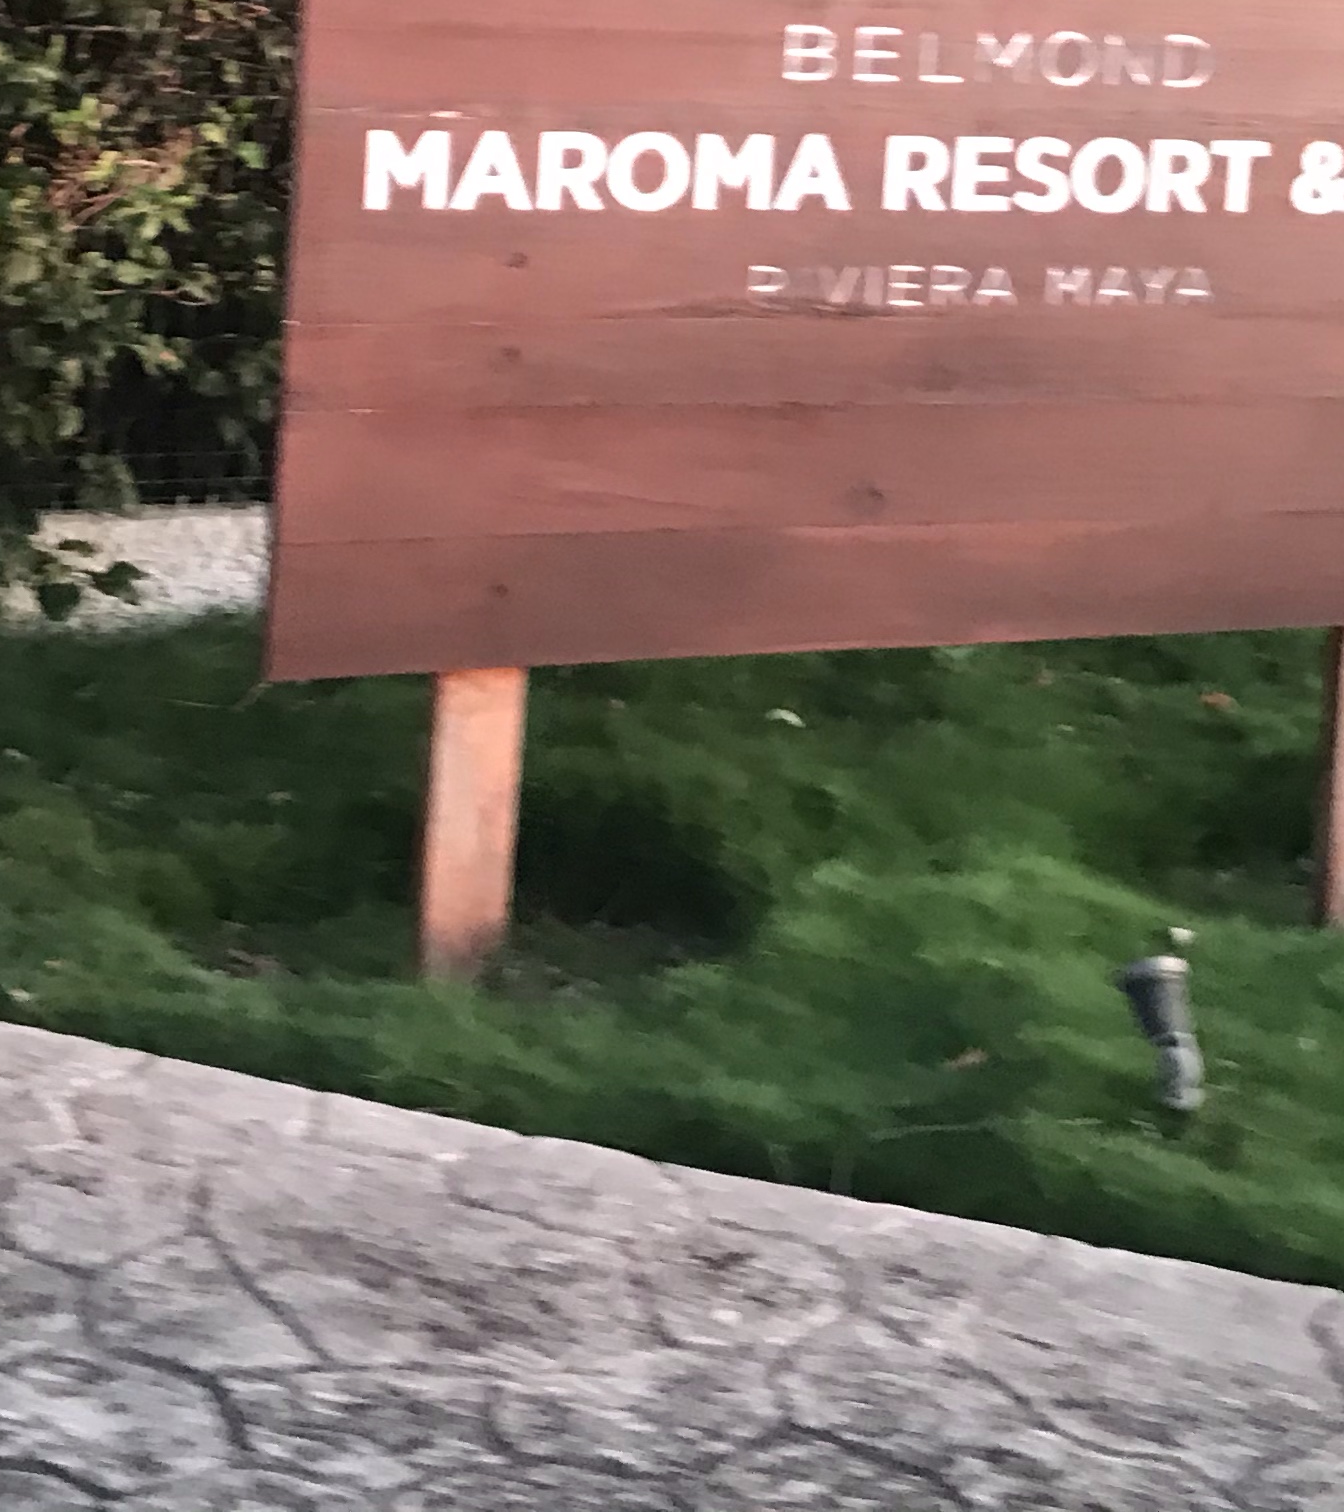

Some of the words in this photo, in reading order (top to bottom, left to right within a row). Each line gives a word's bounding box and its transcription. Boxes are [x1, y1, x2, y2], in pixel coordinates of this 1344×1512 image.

[781, 23, 1215, 89] BELMOND
[361, 128, 852, 212] MAROMA
[881, 134, 1273, 215] RESORT
[747, 263, 1018, 308] RVIERA
[1045, 265, 1214, 306] MAYA
